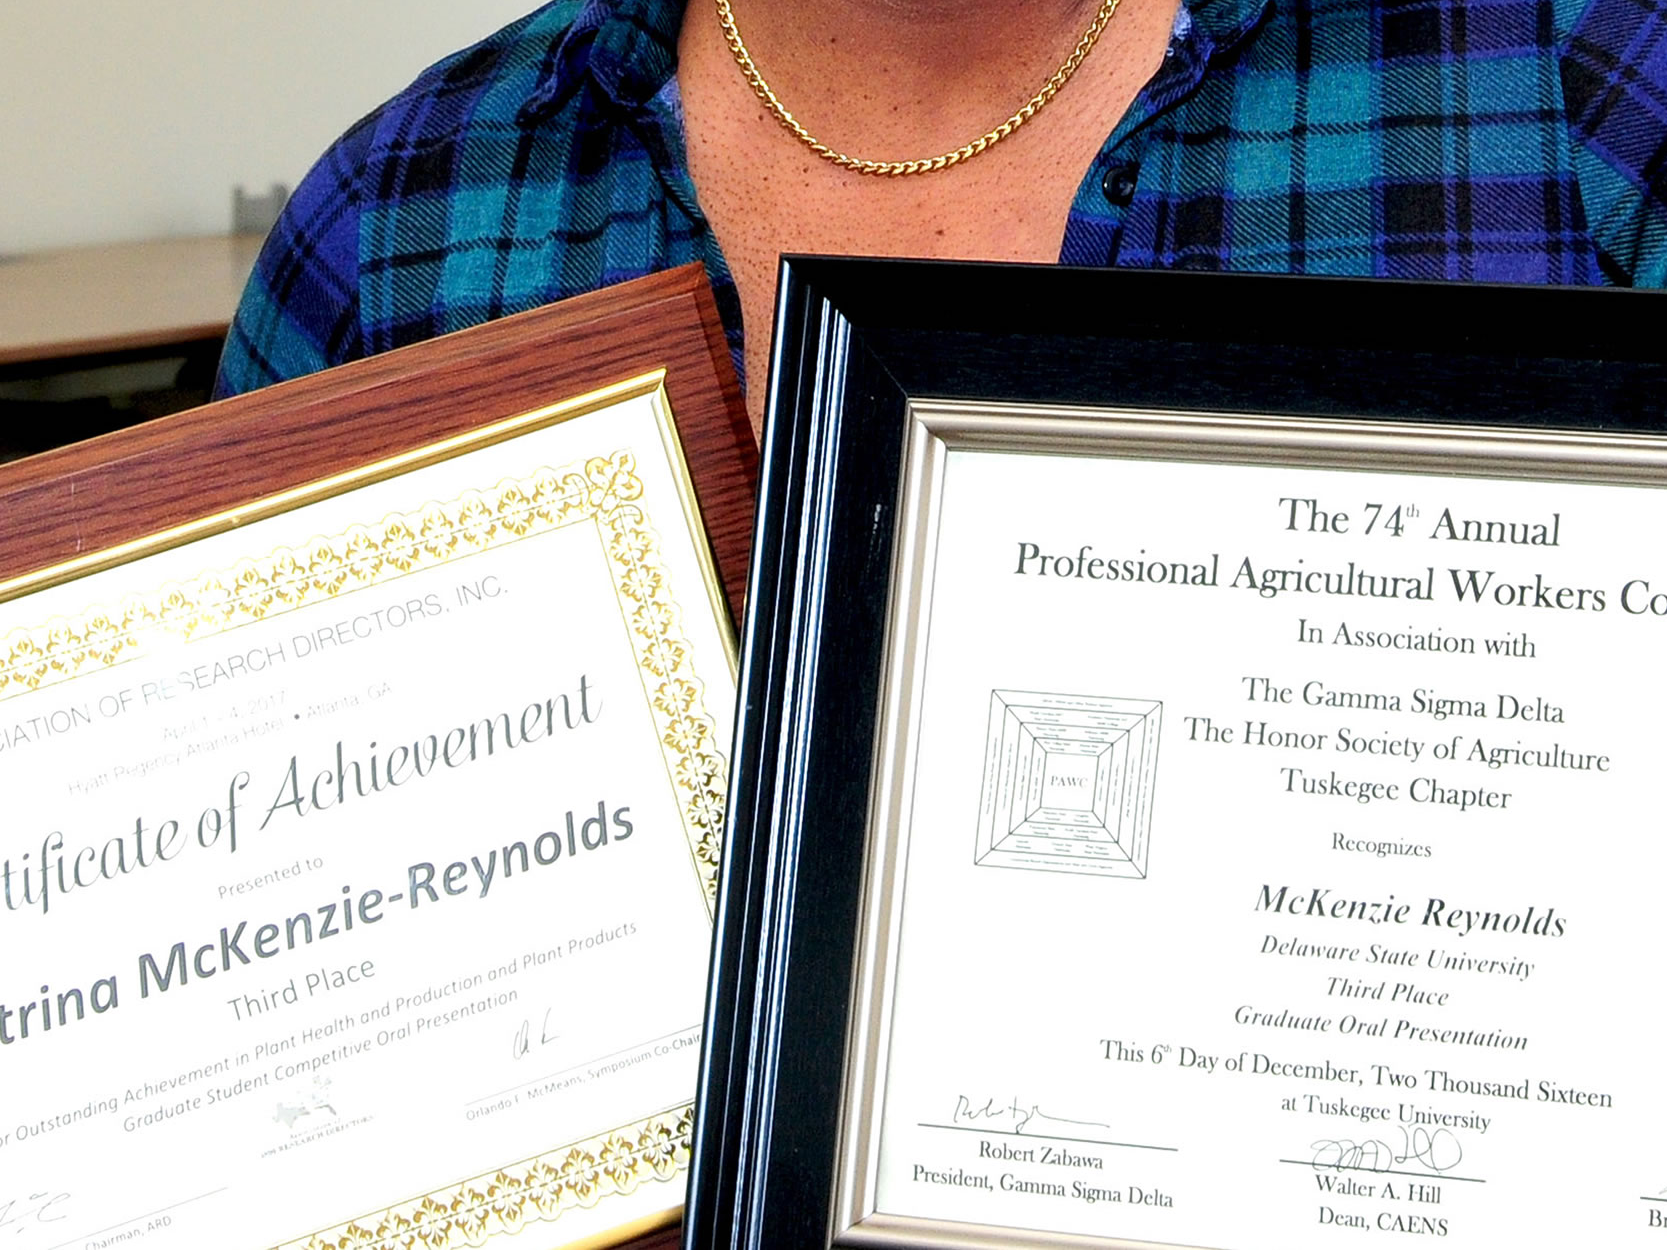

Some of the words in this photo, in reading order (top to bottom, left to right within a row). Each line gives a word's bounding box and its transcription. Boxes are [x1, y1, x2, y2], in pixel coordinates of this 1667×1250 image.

[1279, 498, 1349, 533] The
[1429, 508, 1560, 546] Annual
[1015, 543, 1218, 586] Professional
[1230, 557, 1434, 600] Agricultural
[1448, 569, 1605, 611] Workers
[99, 689, 132, 717] OF
[141, 642, 286, 705] RESEARCH
[292, 594, 449, 658] DIRECTORS,
[456, 576, 508, 606] INC.
[1298, 619, 1323, 643] In
[1333, 622, 1474, 654] Association
[1485, 632, 1535, 657] with
[1242, 677, 1292, 703] The
[1303, 682, 1401, 711] Gamma
[1411, 689, 1486, 720] Sigma
[1497, 695, 1564, 723] Delta
[1184, 717, 1233, 743] The
[1244, 721, 1328, 749] Honor
[1336, 728, 1425, 762] Society
[1433, 735, 1463, 760] of
[1467, 738, 1610, 771] Agriculture
[1, 817, 187, 914] tificate
[198, 771, 252, 853] of
[259, 674, 603, 831] Achievement
[1050, 775, 1088, 789] PAWC
[1281, 768, 1398, 803] Tuskegee
[1410, 778, 1512, 811] Chapter
[1333, 833, 1431, 857] Recognizes
[139, 801, 633, 998] McKenzie-Reynolds
[218, 861, 301, 899] Presented
[306, 858, 323, 870] to
[1255, 885, 1410, 924] McKenzie
[1422, 899, 1566, 937] Reynolds
[1260, 935, 1360, 961] Delaware
[1366, 944, 1419, 967] State
[1427, 949, 1535, 981] University
[227, 979, 298, 1020] Third
[306, 961, 375, 996] Place
[1328, 978, 1385, 1000] Third
[1392, 983, 1449, 1006] Place
[16, 1098, 117, 1140] Outstanding
[124, 1059, 229, 1104] Achievement
[236, 1054, 249, 1066] in
[255, 1036, 295, 1059] Plant
[303, 1015, 354, 1044] Health
[361, 1002, 390, 1024] and
[396, 975, 482, 1011] Production
[488, 959, 517, 981] and
[524, 946, 562, 969] Plant
[569, 923, 636, 954] Products
[1235, 1006, 1331, 1031] Graduate
[1339, 1016, 1387, 1036] Oral
[1394, 1020, 1527, 1050] Presentation
[124, 1098, 200, 1132] Graduate
[207, 1073, 268, 1104] Student
[275, 1040, 371, 1080] Competitive
[377, 1022, 410, 1046] Oral
[417, 991, 517, 1032] Presentation
[1100, 1040, 1143, 1062] This
[1179, 1047, 1218, 1073] Day
[1225, 1053, 1248, 1071] of
[1252, 1054, 1362, 1086] December,
[1371, 1065, 1417, 1088] Two
[1424, 1070, 1528, 1099] Thousand
[1537, 1081, 1611, 1107] Sixteen
[466, 1099, 512, 1121] Orlando
[587, 1050, 652, 1080] Symposium
[1282, 1098, 1296, 1111] at
[1304, 1095, 1390, 1122] Tuskegee
[1400, 1104, 1490, 1134] University
[980, 1141, 1034, 1162] Robert
[1040, 1147, 1102, 1169] Zabawa
[914, 1165, 993, 1191] President,
[1000, 1174, 1065, 1196] Gamma
[1072, 1181, 1121, 1203] Sigma
[1129, 1187, 1172, 1207] Delta
[1316, 1175, 1376, 1197] Walter
[1381, 1182, 1400, 1199] A.
[1409, 1184, 1440, 1203] Hill
[147, 1215, 172, 1232] ARD
[1320, 1207, 1369, 1231] Dean,
[1377, 1213, 1448, 1236] CAENS
